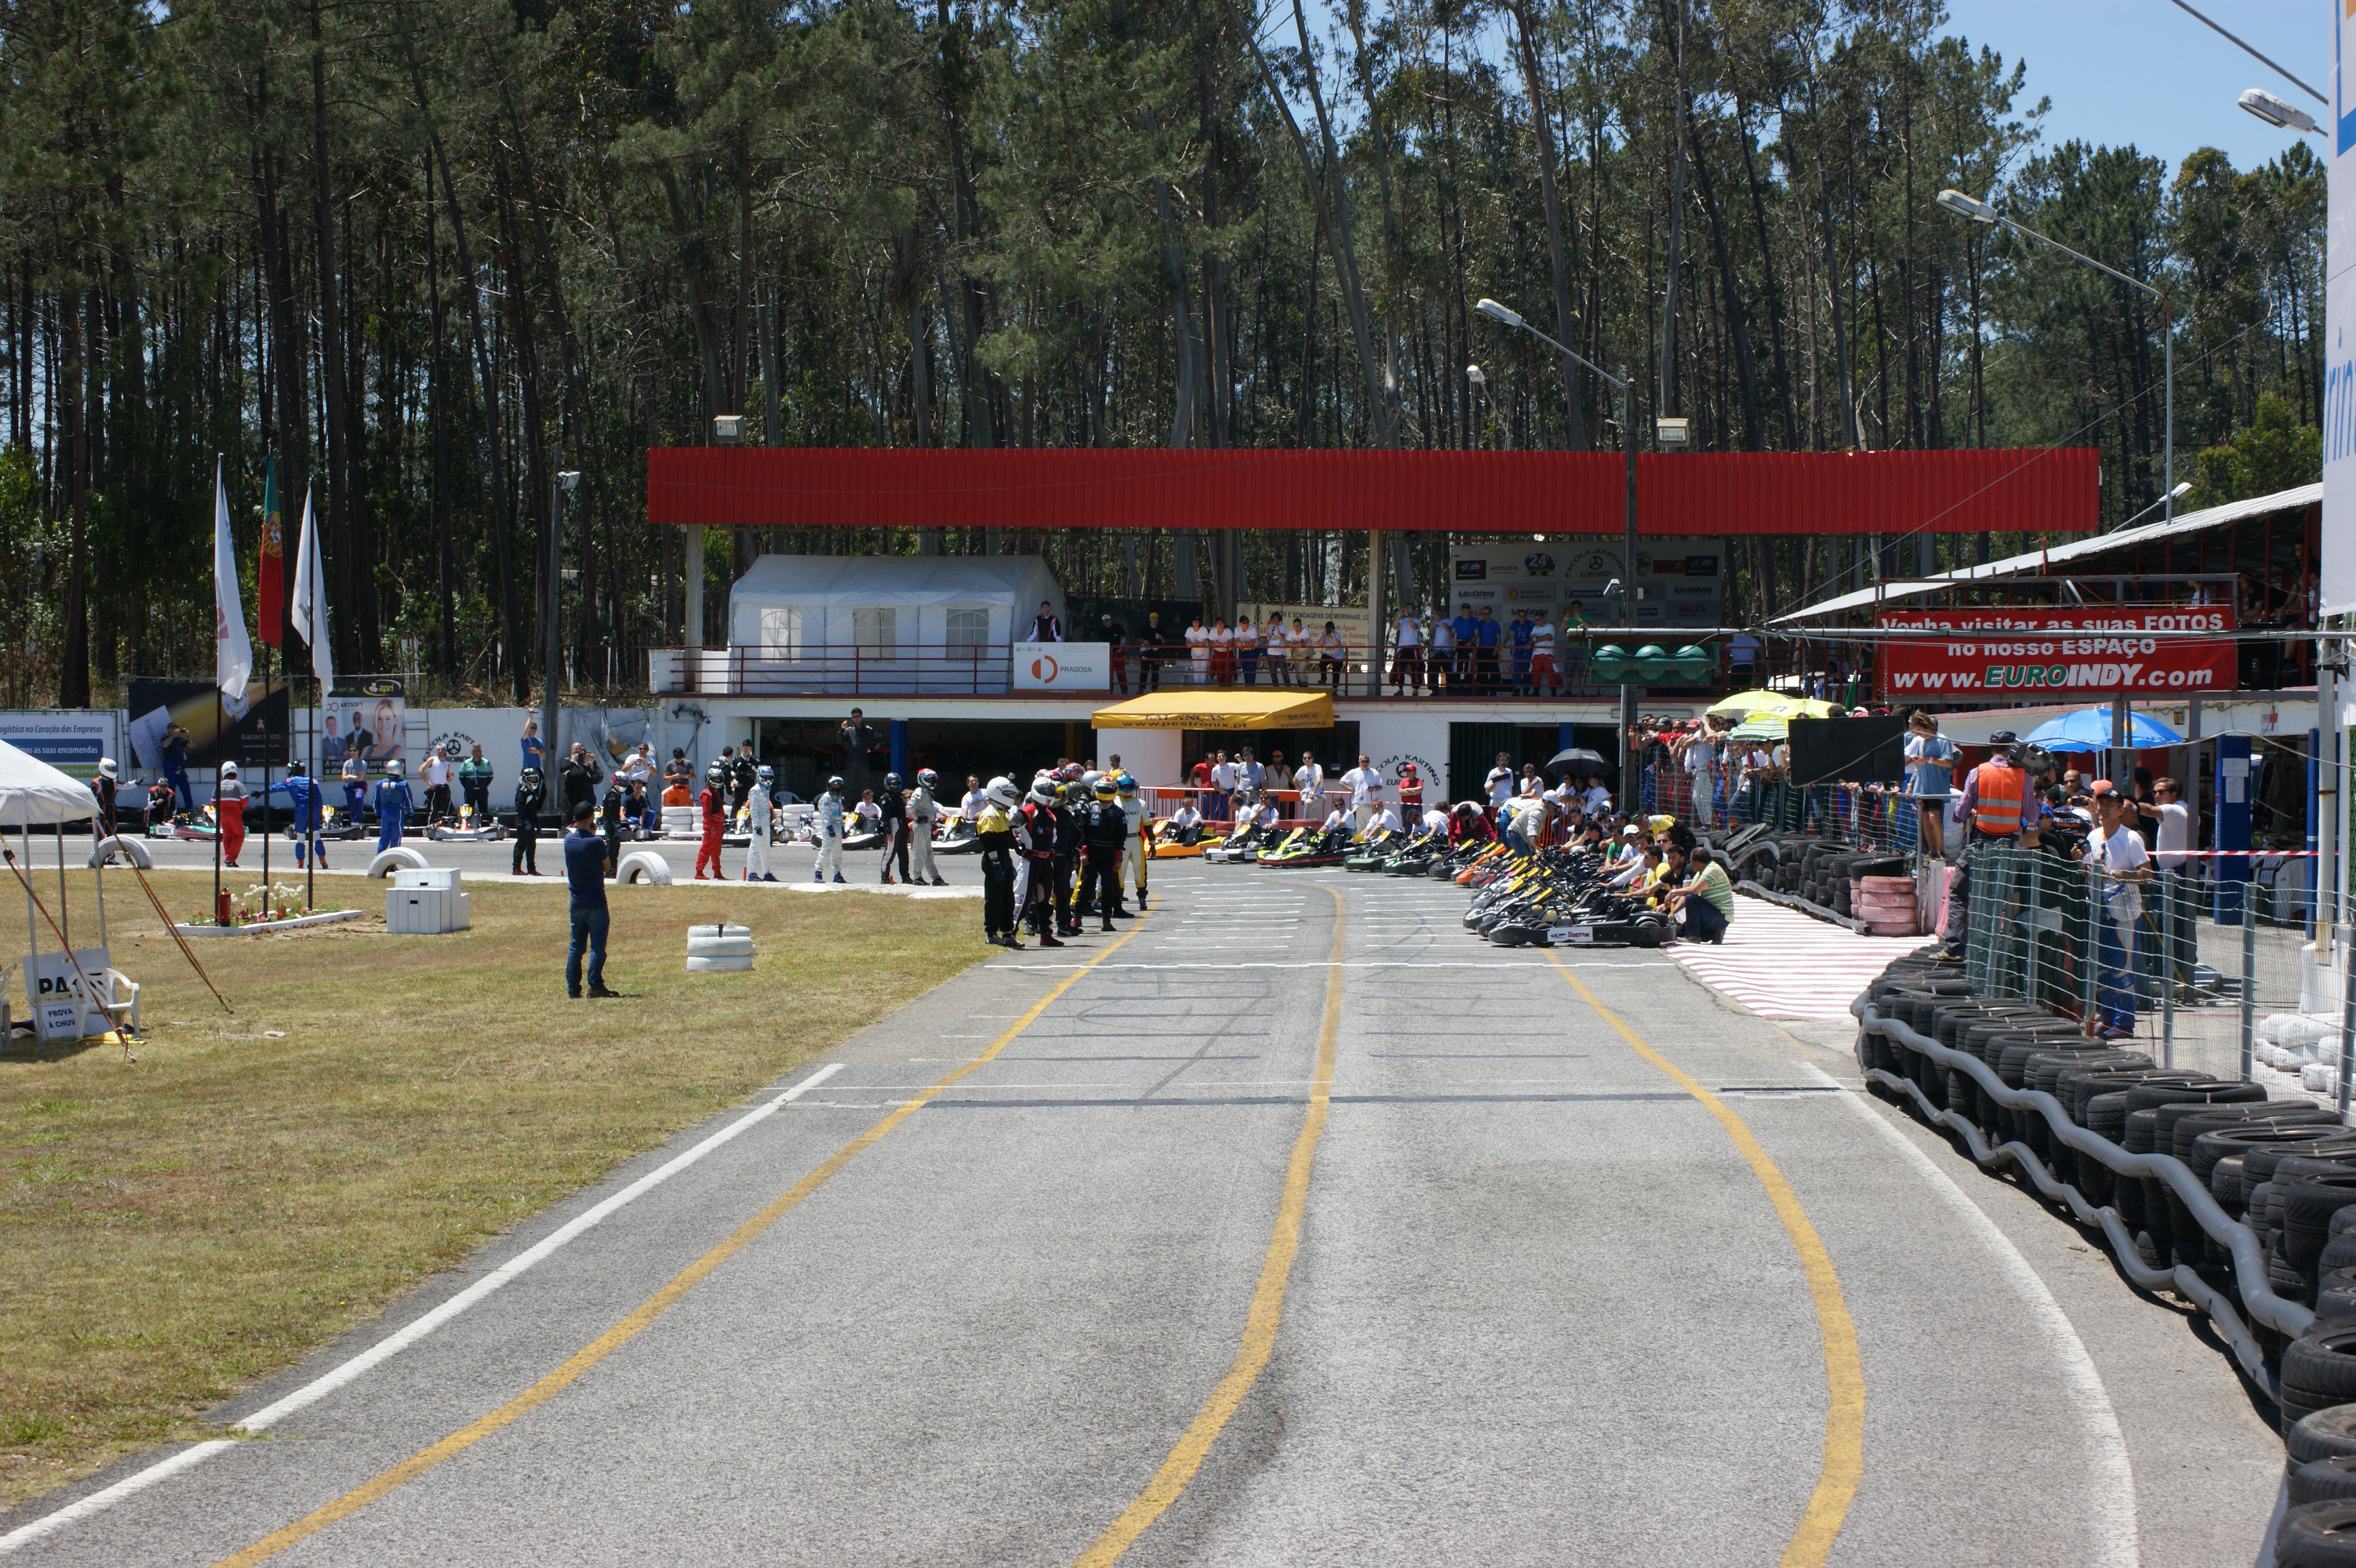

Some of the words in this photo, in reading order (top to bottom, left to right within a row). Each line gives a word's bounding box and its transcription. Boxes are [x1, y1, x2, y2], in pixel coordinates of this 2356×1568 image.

[1529, 555, 1547, 566] 24
[1565, 550, 1591, 578] ESCOLA
[1881, 618, 1952, 630] Venha
[1961, 618, 2037, 630] visitar
[2046, 620, 2073, 630] as
[2082, 619, 2137, 630] suas
[2144, 613, 2223, 630] FOTOS
[1342, 624, 1357, 632] Águas
[1948, 643, 1975, 656] no
[1984, 642, 2054, 656] nosso
[2062, 638, 2156, 658] ESPAÇO
[1893, 663, 2213, 688] www.EUROINDY.com
[379, 683, 395, 694] apri
[0, 724, 24, 735] ogística
[34, 724, 60, 735] Coração
[73, 724, 103, 735] Empresas
[144, 719, 158, 745] RIBEIRO
[57, 746, 98, 754] encomendas
[1376, 755, 1399, 772] COLA
[1405, 754, 1441, 786] KARTING
[48, 1008, 73, 1017] PROVA
[49, 1021, 54, 1029] À
[55, 1018, 75, 1027] CHUV
